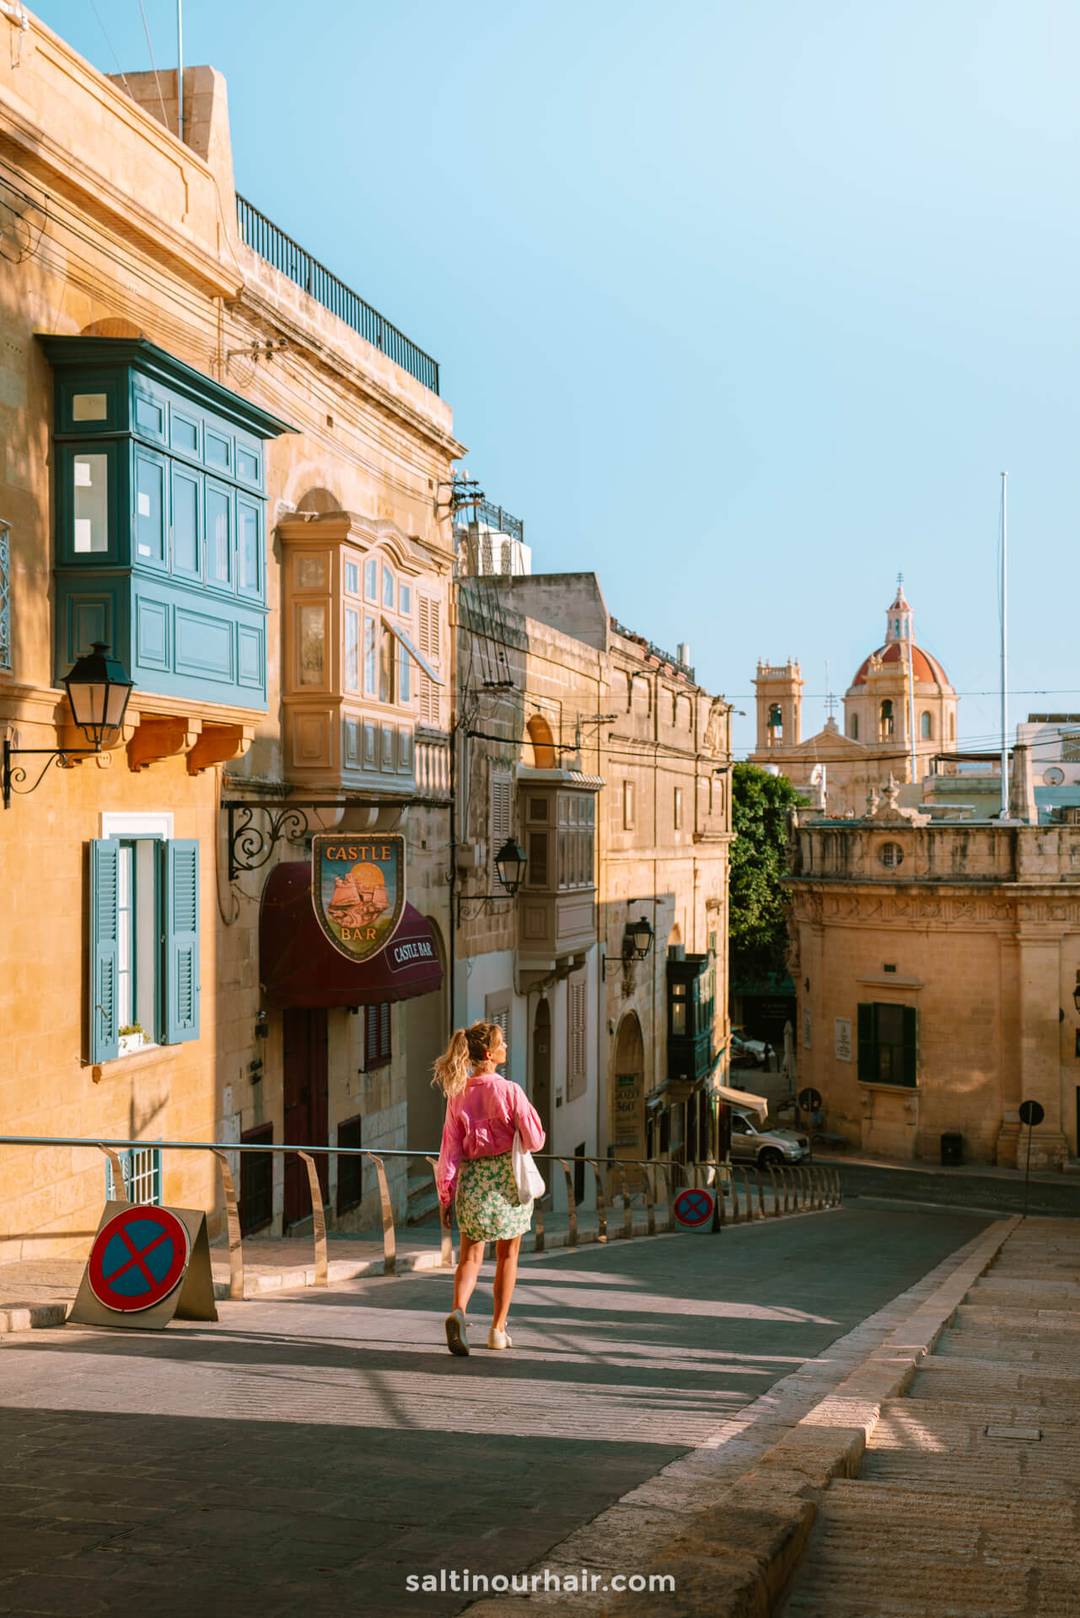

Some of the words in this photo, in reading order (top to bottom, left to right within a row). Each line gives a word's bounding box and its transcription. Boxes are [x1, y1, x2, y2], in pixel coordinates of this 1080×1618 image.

[326, 846, 392, 860] CASTLE
[341, 928, 376, 941] BAR
[394, 943, 418, 963] CASTLE
[417, 942, 433, 956] BAR
